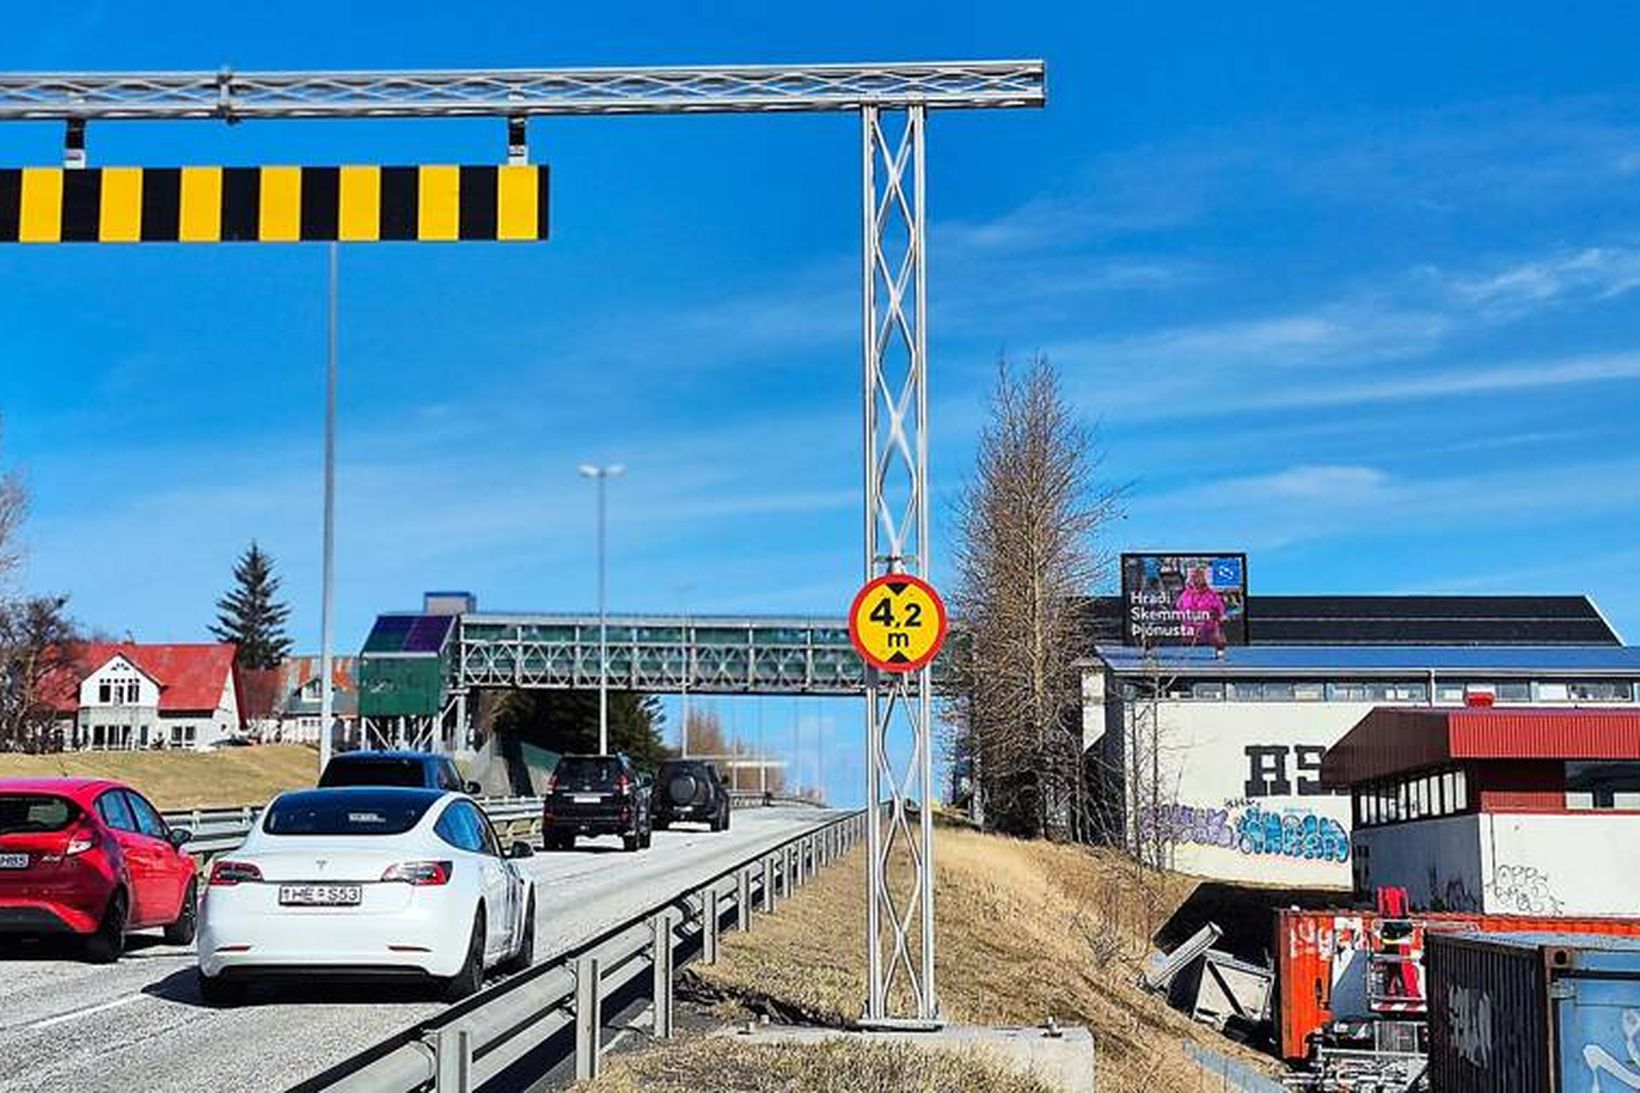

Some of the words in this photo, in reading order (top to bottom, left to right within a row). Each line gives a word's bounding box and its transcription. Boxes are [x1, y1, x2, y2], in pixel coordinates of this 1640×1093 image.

[870, 598, 922, 628] 4,2
[1130, 606, 1210, 621] Skemmtun
[1131, 622, 1195, 639] Þjónusta
[887, 632, 909, 647] m
[1245, 745, 1352, 796] HS
